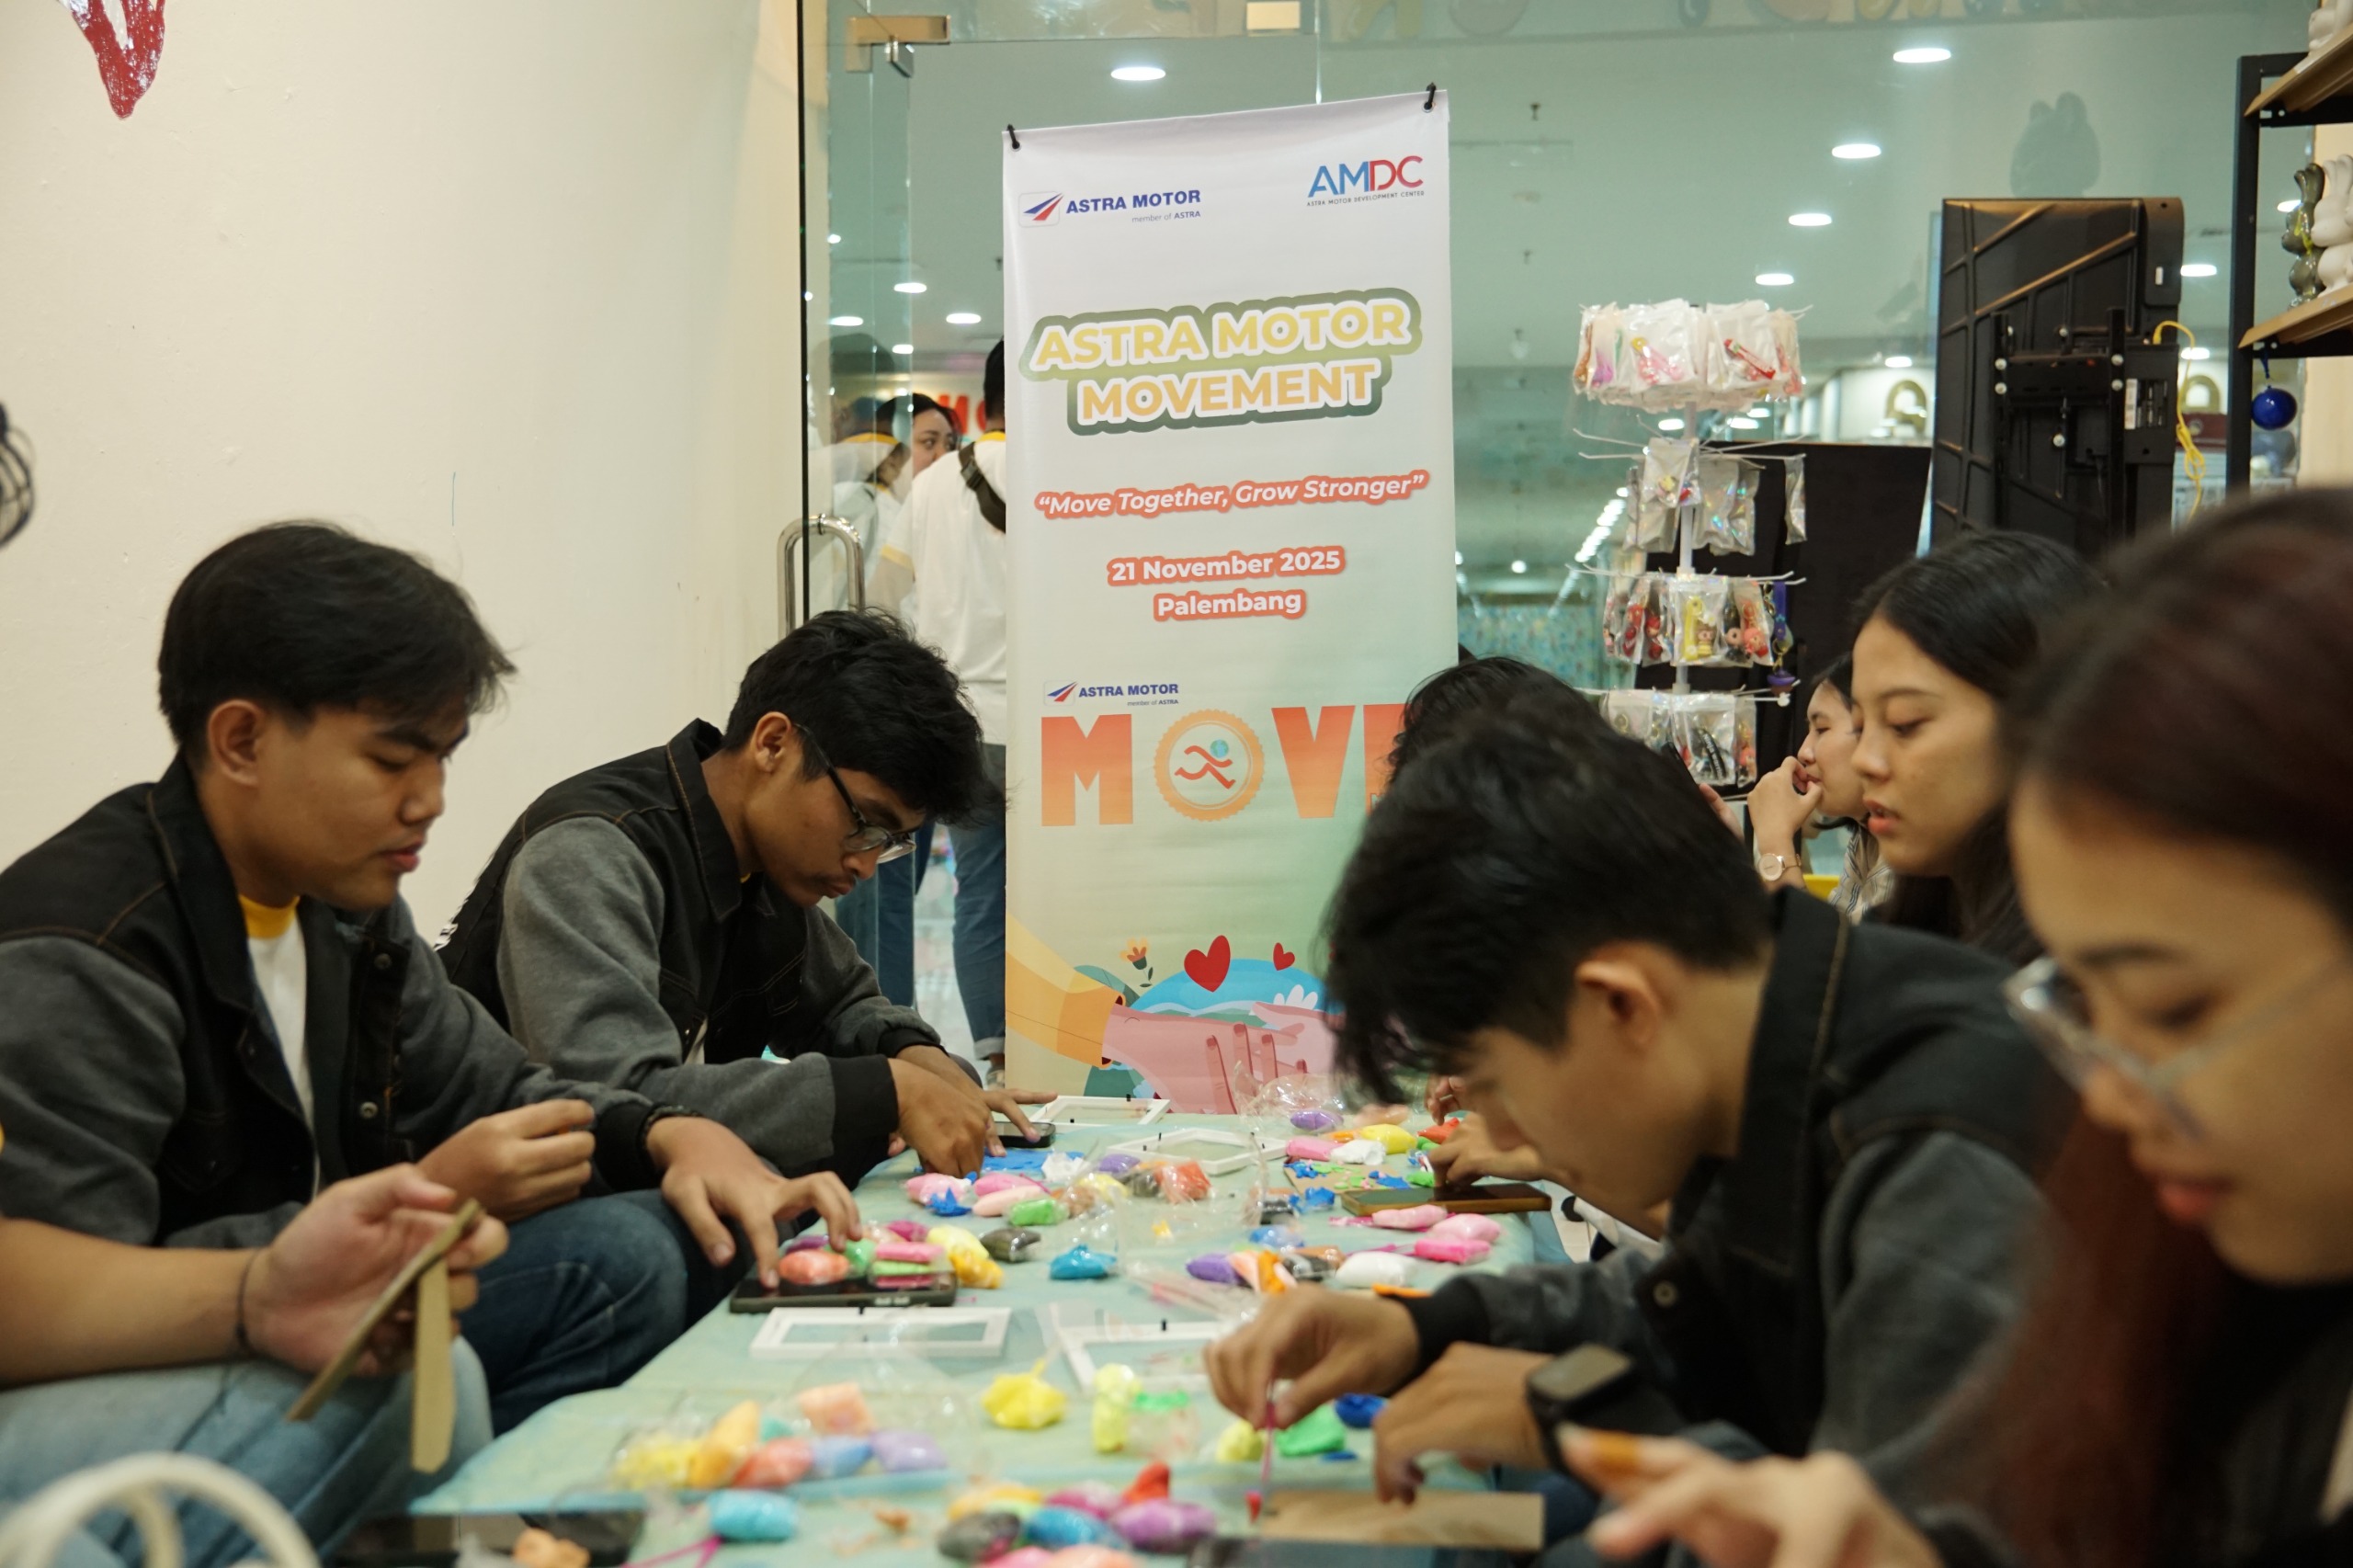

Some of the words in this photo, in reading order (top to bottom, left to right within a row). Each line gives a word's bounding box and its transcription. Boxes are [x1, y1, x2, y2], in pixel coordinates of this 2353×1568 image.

[1307, 154, 1424, 199] AMDC
[1066, 196, 1127, 214] ASTRA
[1132, 189, 1201, 209] MOTOR
[1306, 199, 1326, 208] ASTRA
[1327, 197, 1352, 206] MOTOR
[1354, 192, 1398, 202] DEVELOPMENT
[1400, 190, 1425, 199] CENTER
[1131, 213, 1162, 224] member
[1164, 212, 1172, 222] of
[1174, 210, 1201, 220] ASTRA
[1034, 319, 1204, 368] ASTRA
[1216, 302, 1412, 353] MOTOR
[1081, 362, 1377, 422] MOVEMENT
[1118, 486, 1229, 513] Together,
[1235, 483, 1299, 505] Grow
[1111, 562, 1136, 582] 21
[1142, 553, 1274, 580] November
[1279, 550, 1341, 574] 2025
[1157, 590, 1302, 618] Palembang
[1078, 686, 1124, 698] ASTRA
[1127, 683, 1179, 696] MOTOR
